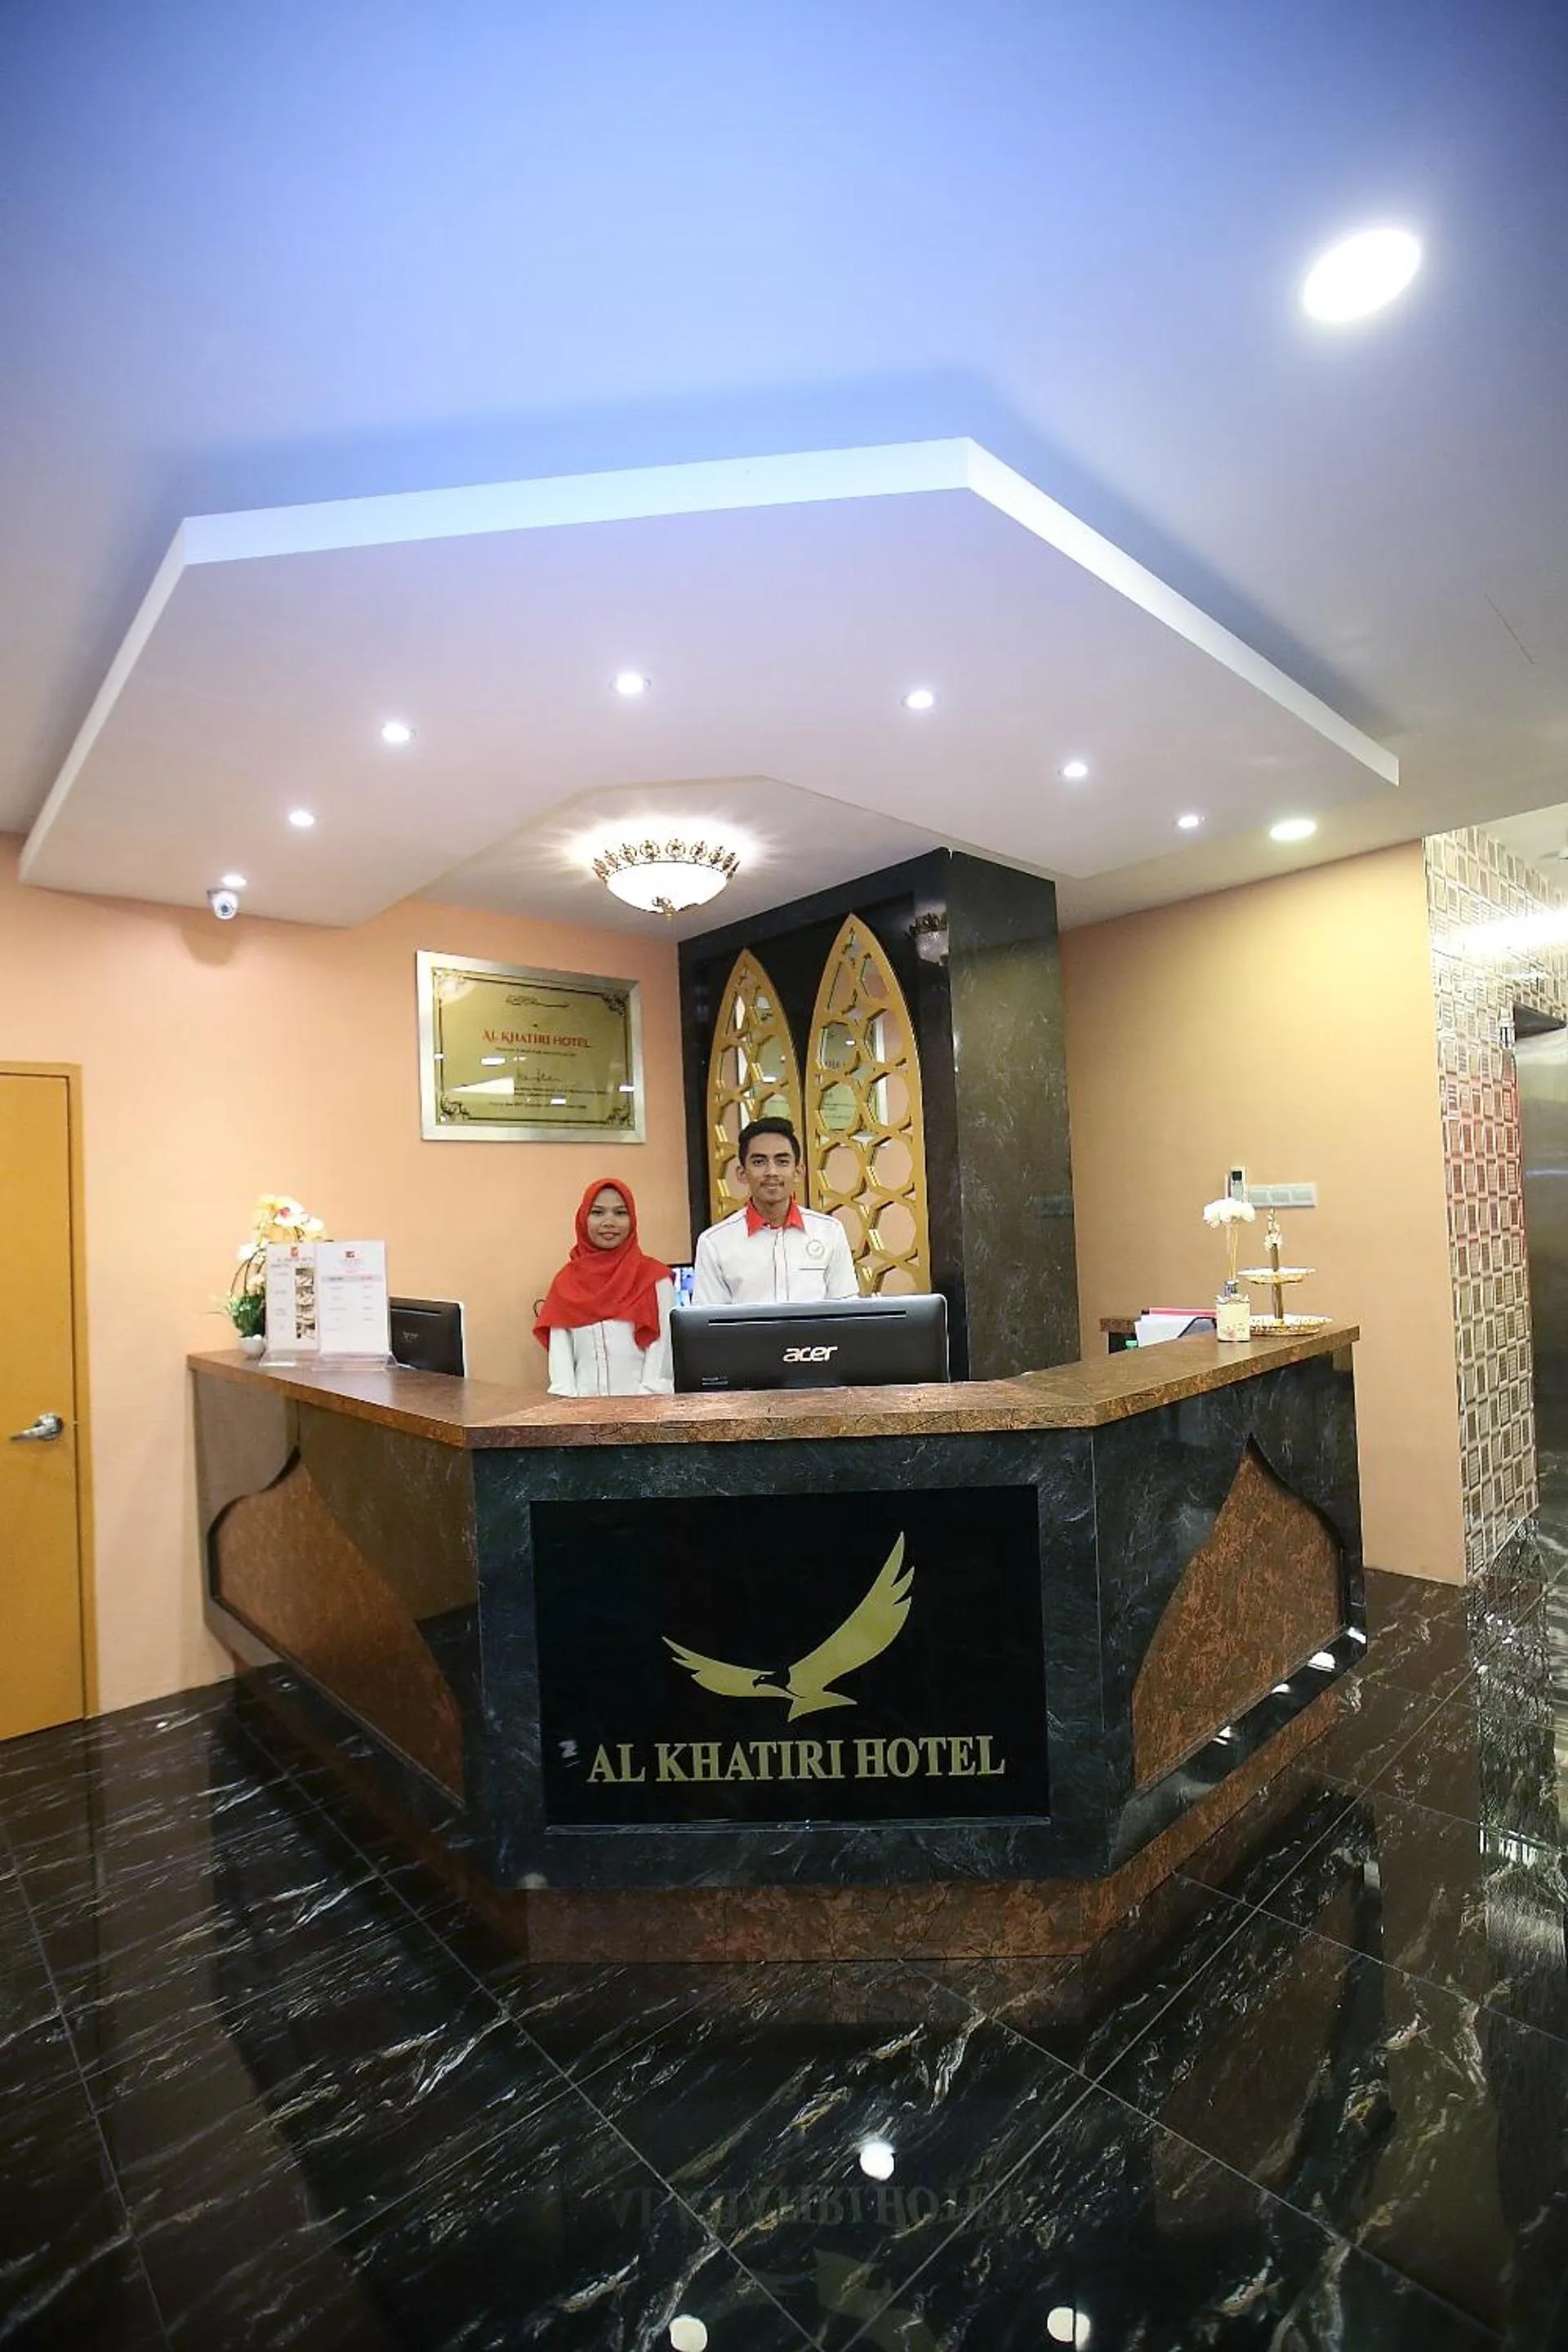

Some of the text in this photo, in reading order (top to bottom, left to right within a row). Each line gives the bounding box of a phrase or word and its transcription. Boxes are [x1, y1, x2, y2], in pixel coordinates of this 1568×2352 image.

[482, 1029, 500, 1043] AL
[553, 1035, 590, 1048] HOTEL
[782, 1346, 838, 1362] acer
[587, 1735, 1005, 1783] AL KHATIRI HOTEL
